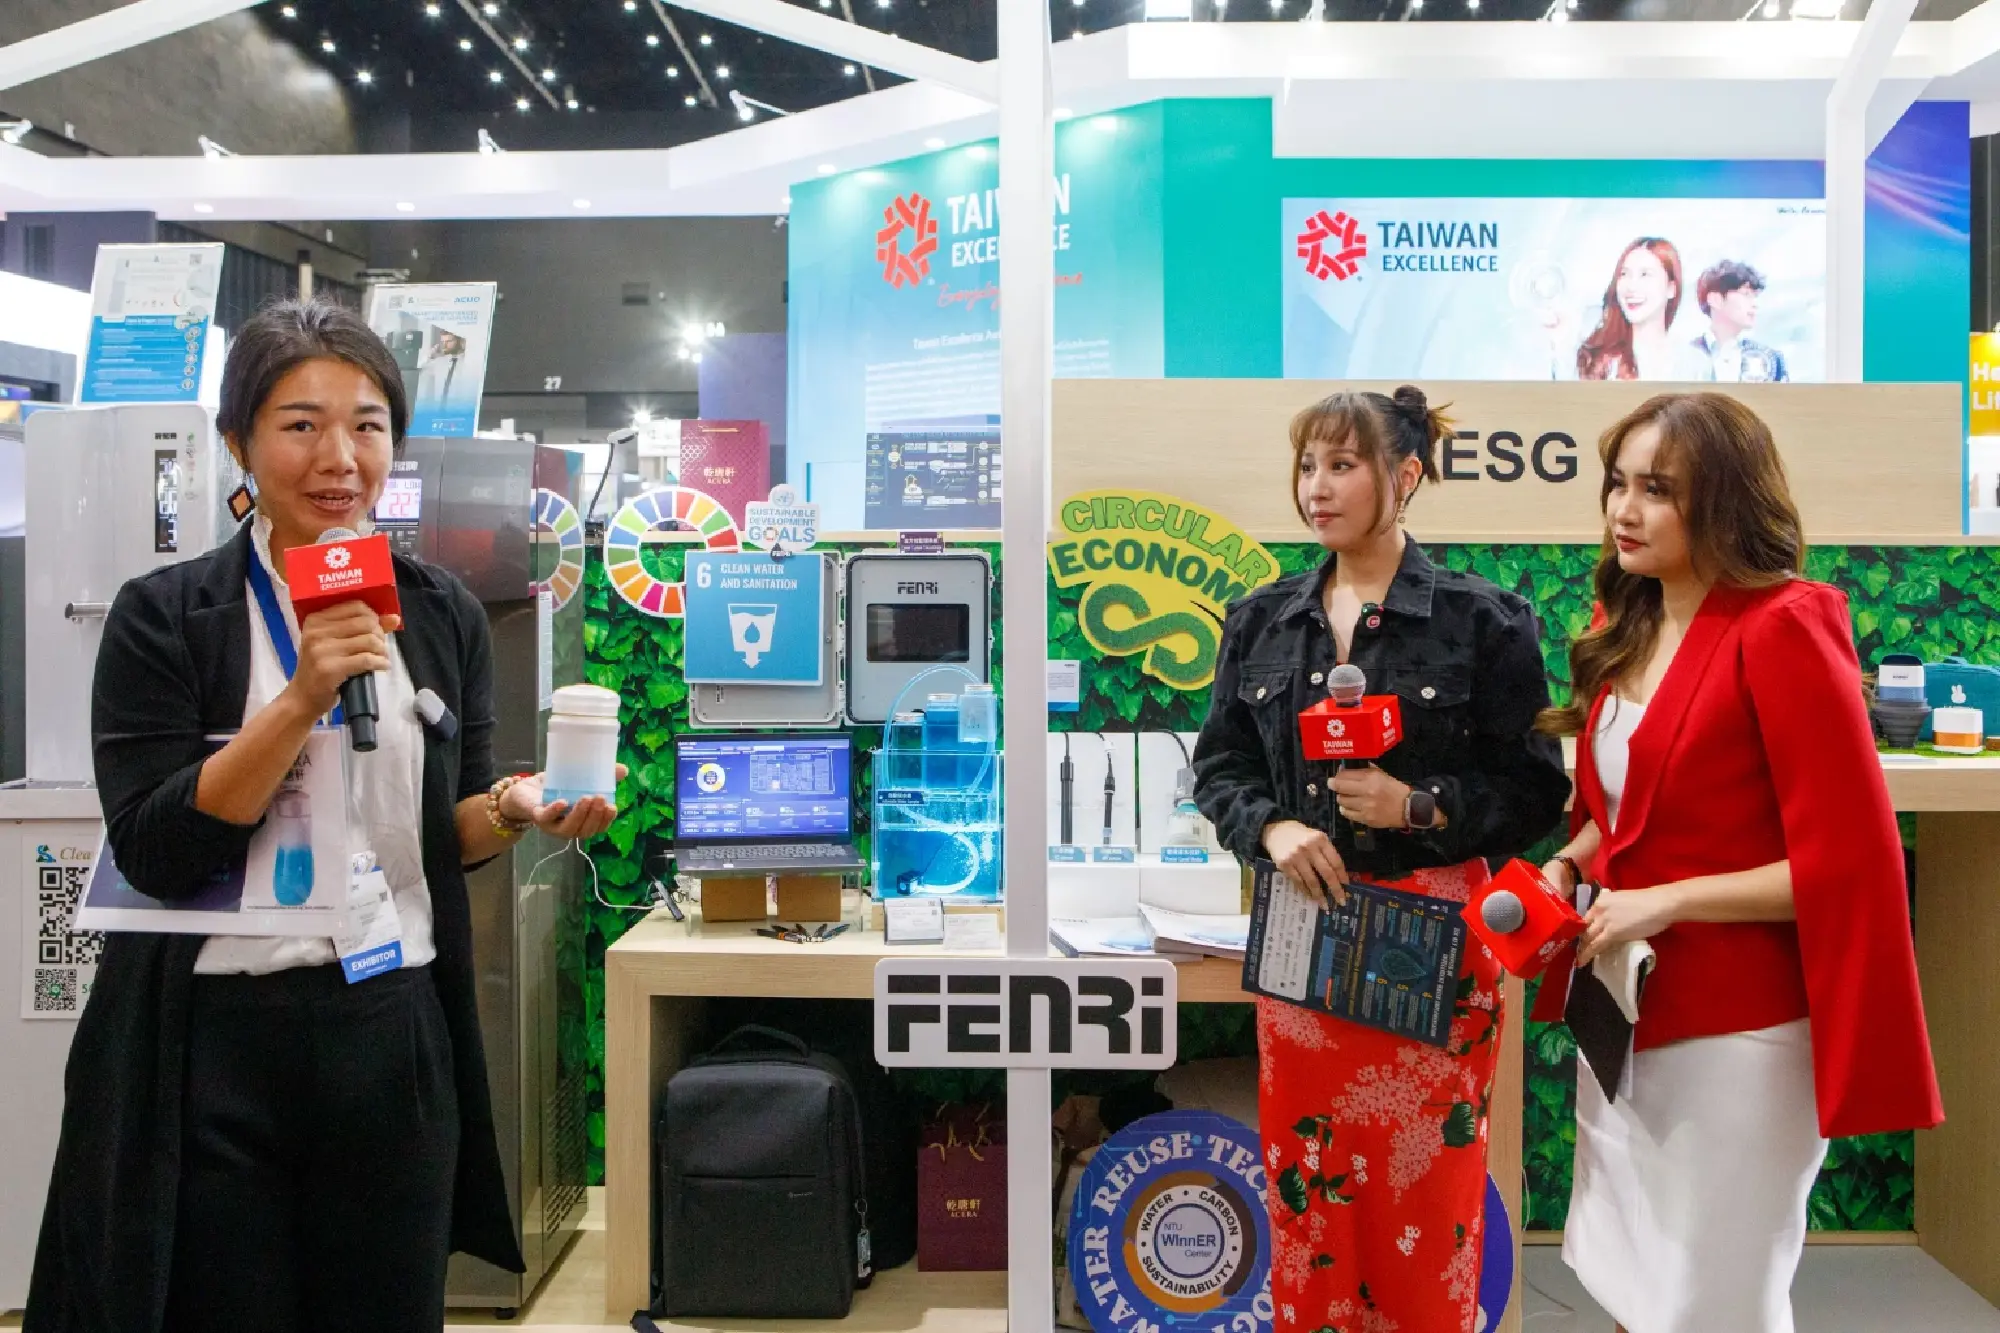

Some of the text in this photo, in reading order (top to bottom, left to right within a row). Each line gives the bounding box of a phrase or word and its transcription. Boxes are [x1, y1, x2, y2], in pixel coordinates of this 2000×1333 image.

[946, 172, 1070, 234] TAIN
[952, 224, 1070, 267] EXCEE
[1378, 221, 1499, 248] TAIWAN
[1382, 254, 1499, 272] EXCELLENCE
[1441, 431, 1578, 482] ESG
[750, 509, 816, 517] SUSTAINABLE
[750, 518, 816, 526] DEVELOPMENT
[750, 526, 816, 543] GOALS
[1062, 496, 1272, 588] CIRCULAR
[318, 568, 363, 584] TAIWAN
[696, 562, 712, 588] 6
[720, 564, 784, 574] CLEAN WATER
[1052, 539, 1248, 605] ECONOM
[720, 579, 798, 589] AND SANITATION
[60, 846, 93, 860] Clea
[351, 949, 396, 972] EXHIBITOR
[1092, 1132, 1194, 1216] REUSE
[1141, 1190, 1238, 1235] WATER CARBON
[1184, 1249, 1212, 1257] Center
[1083, 1225, 1159, 1333] WATER
[1143, 1255, 1234, 1295] SUSTAINABILITY
